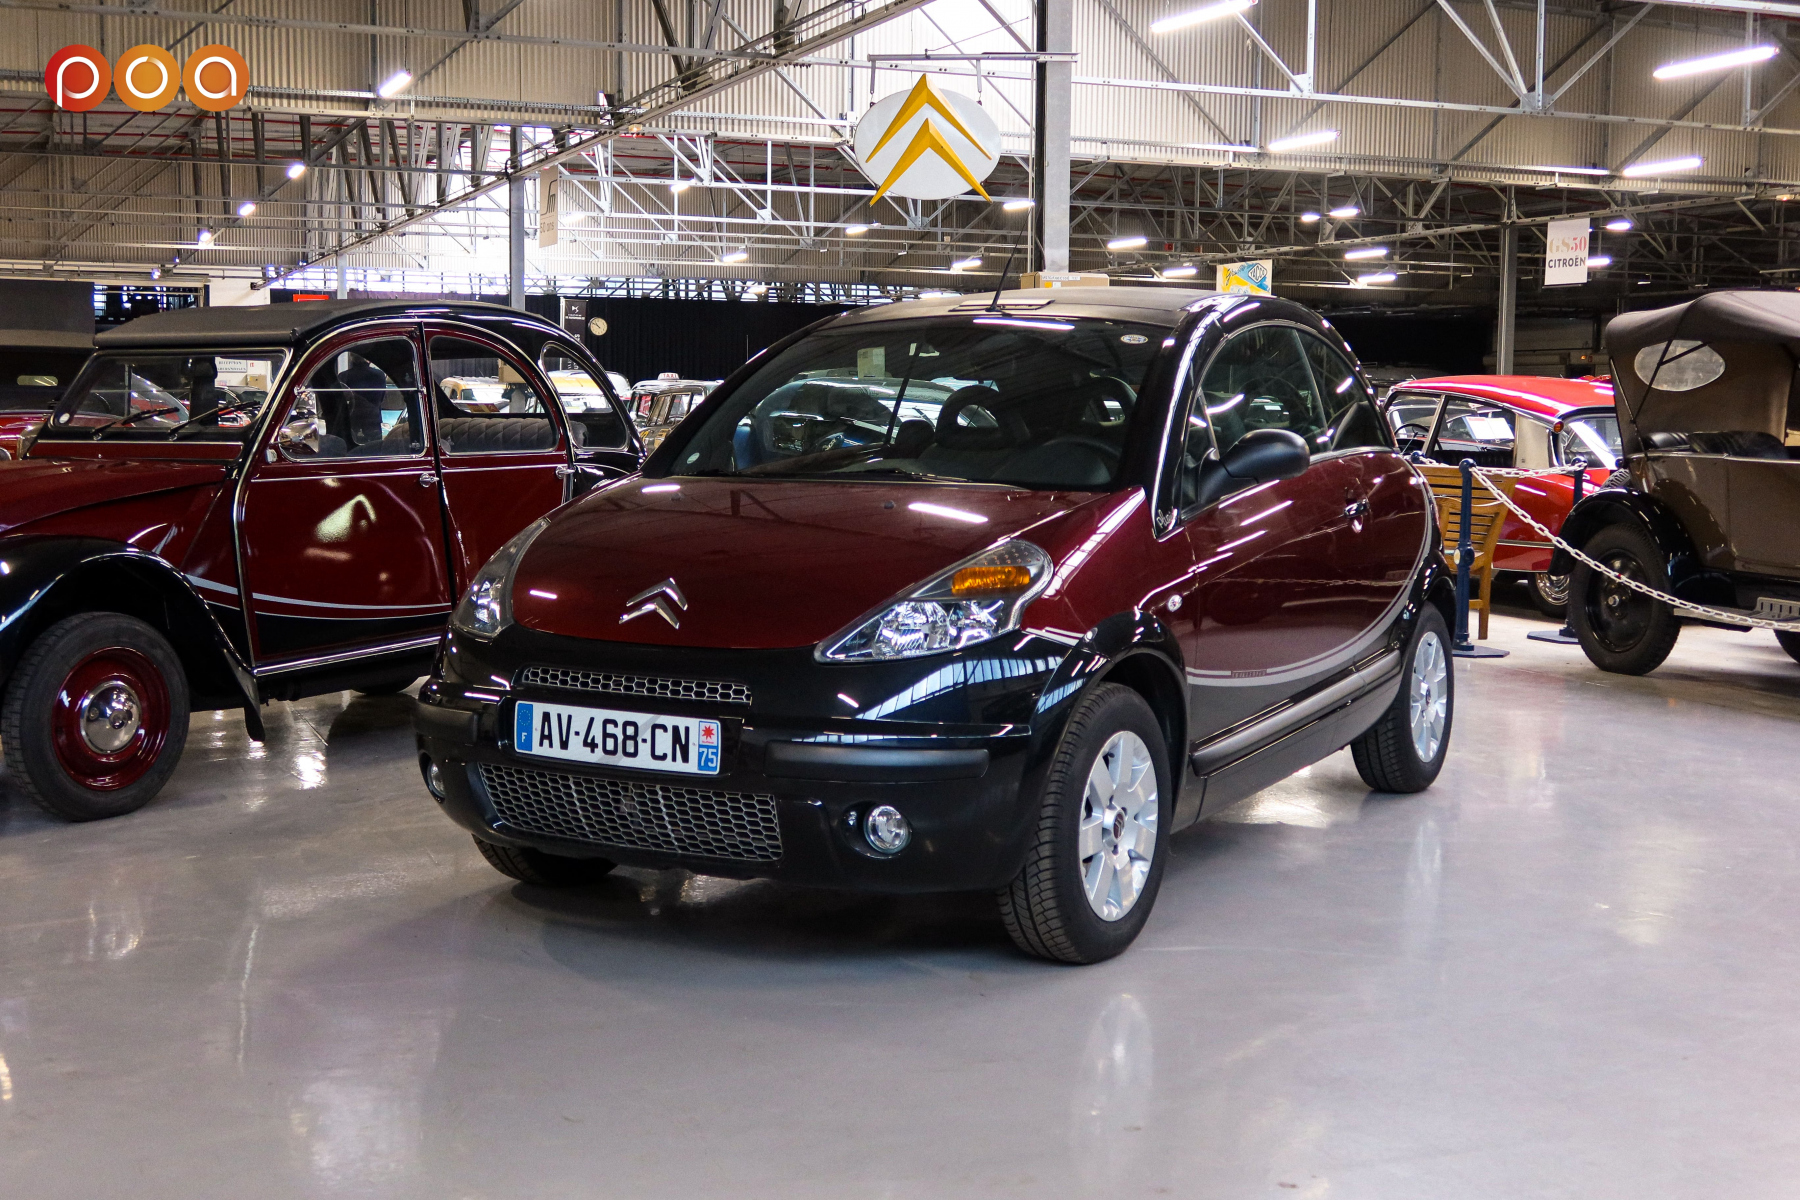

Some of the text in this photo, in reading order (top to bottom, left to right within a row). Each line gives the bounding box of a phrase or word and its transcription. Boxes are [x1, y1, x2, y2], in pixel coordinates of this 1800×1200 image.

[1548, 255, 1587, 268] CITROËN
[521, 732, 528, 743] F
[539, 711, 690, 763] AV-468-CN
[698, 747, 717, 767] 75
